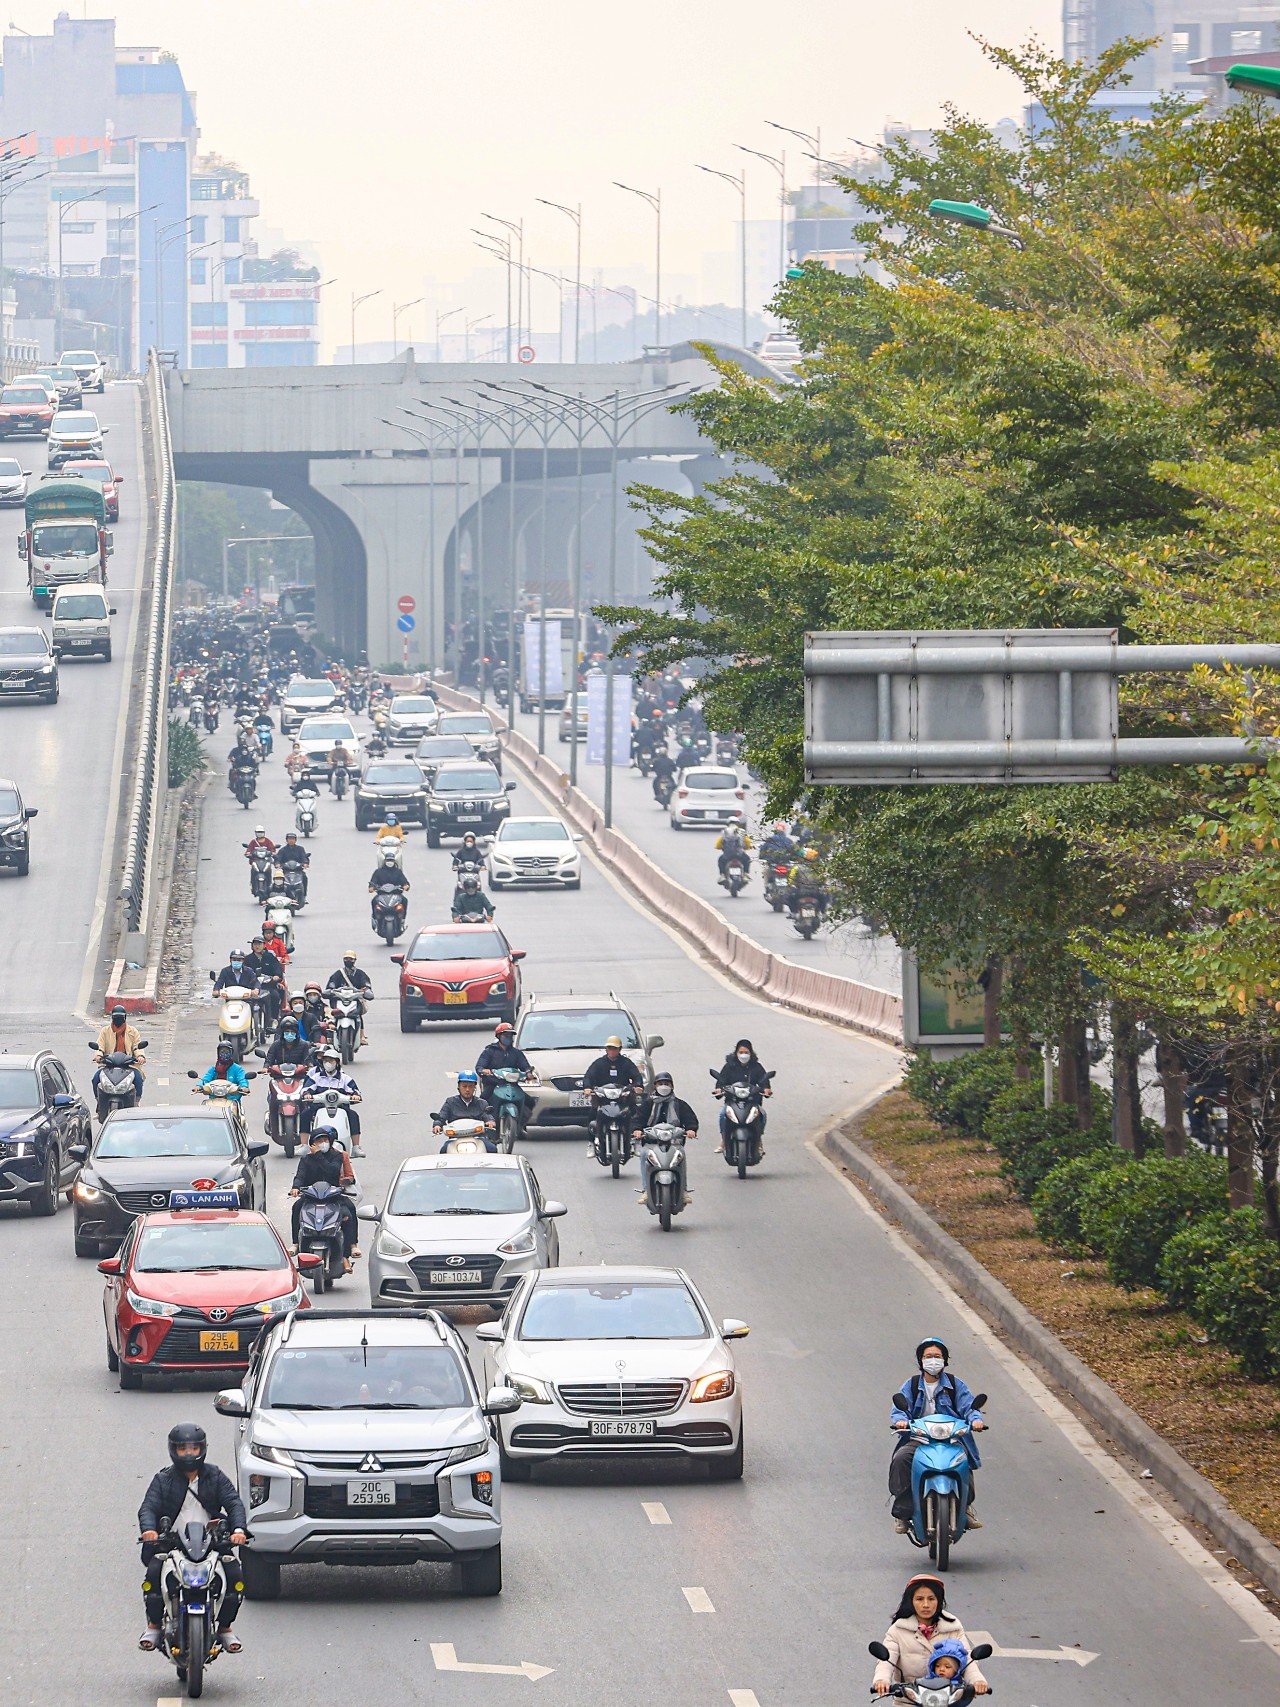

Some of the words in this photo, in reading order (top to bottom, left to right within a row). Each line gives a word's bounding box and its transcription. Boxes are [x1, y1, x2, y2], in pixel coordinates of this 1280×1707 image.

[191, 1195, 211, 1203] LAN
[431, 1272, 480, 1283] 30F-103.74
[210, 1332, 228, 1341] 29E
[204, 1341, 234, 1350] 027.54
[593, 1422, 652, 1435] 30F-678.79
[361, 1482, 382, 1493] 20C
[352, 1493, 391, 1504] 253.96
